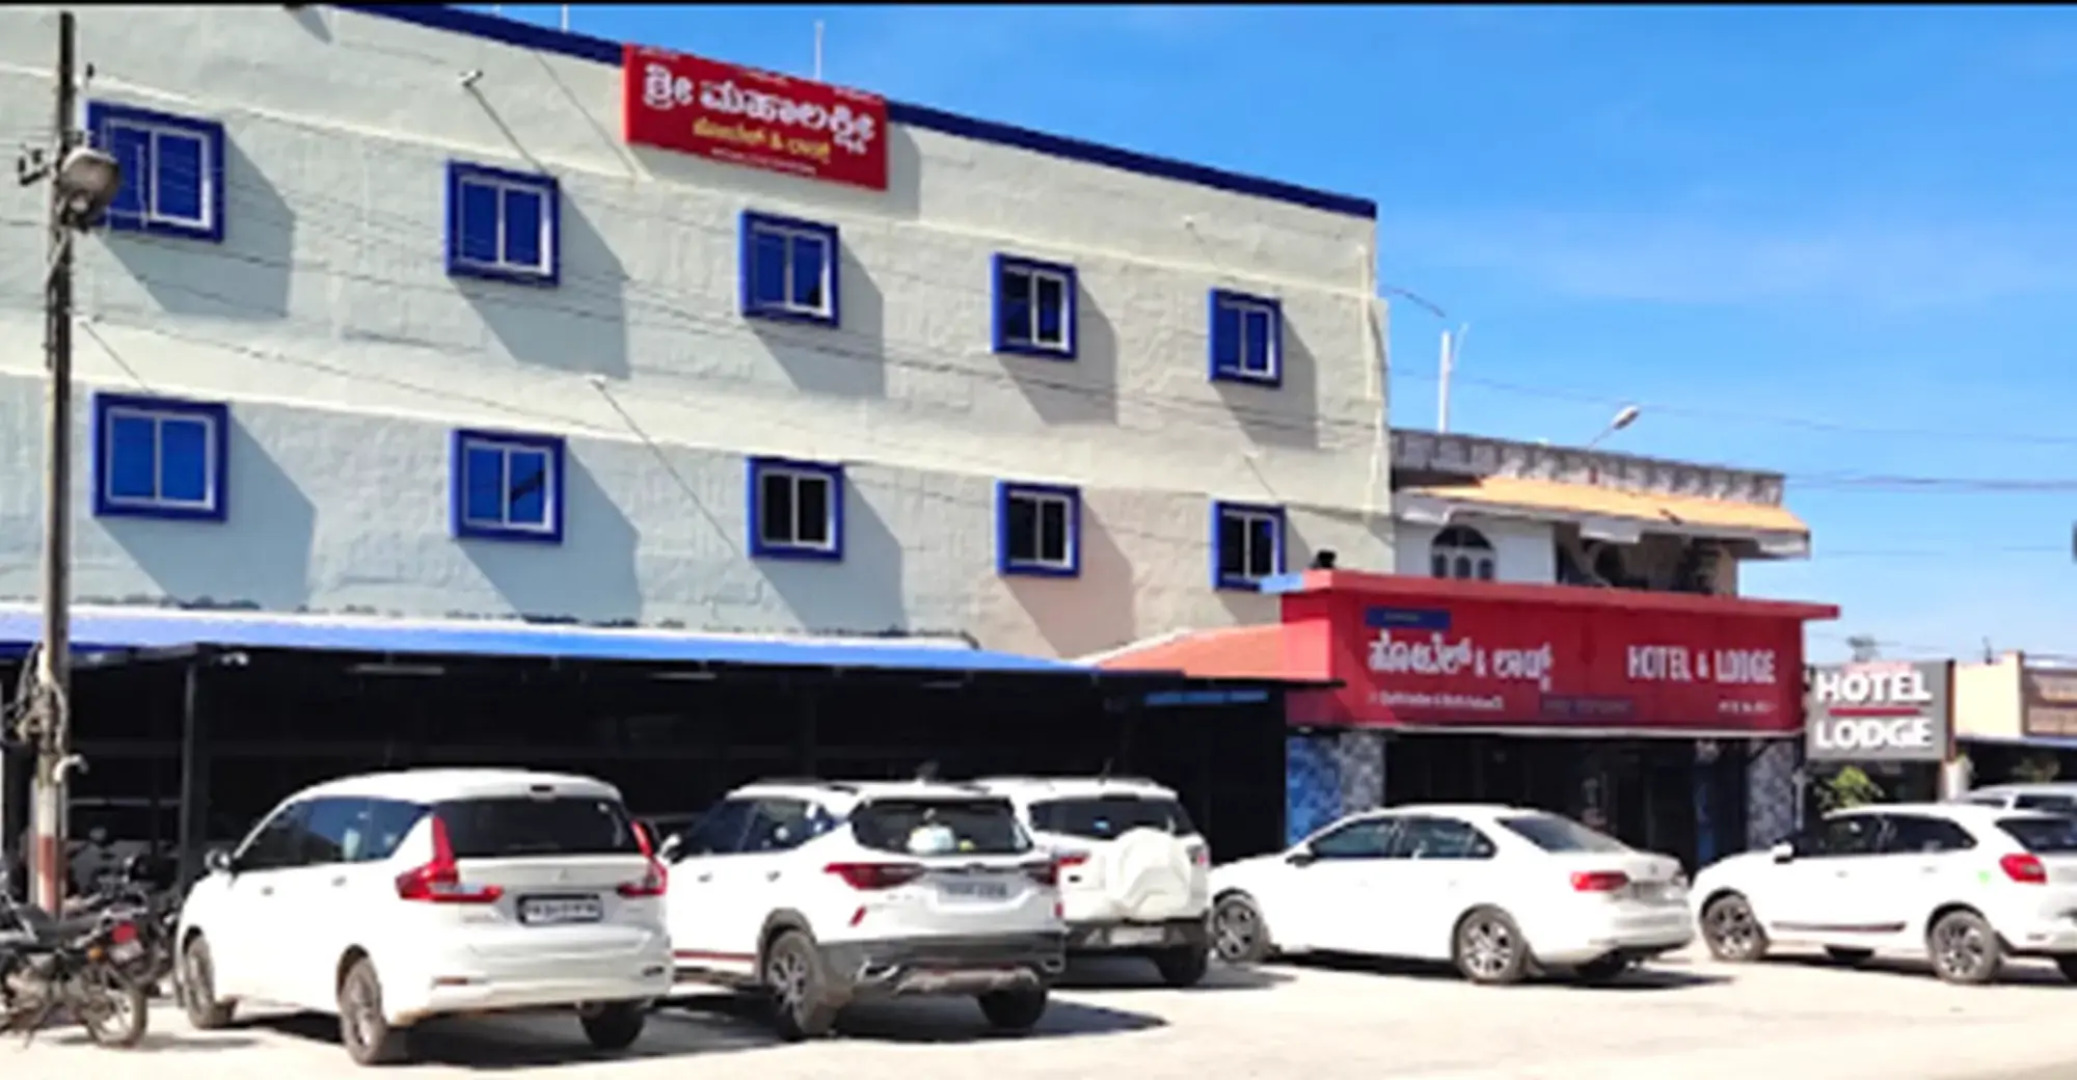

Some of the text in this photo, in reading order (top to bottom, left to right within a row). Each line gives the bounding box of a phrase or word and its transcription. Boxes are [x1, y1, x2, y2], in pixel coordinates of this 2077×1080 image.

[643, 62, 694, 110] ಶ್ರೀ
[1627, 645, 1777, 685] HOTEL & LODGE
[1816, 668, 1933, 702] HOTEL
[1814, 716, 1934, 749] LODGE
